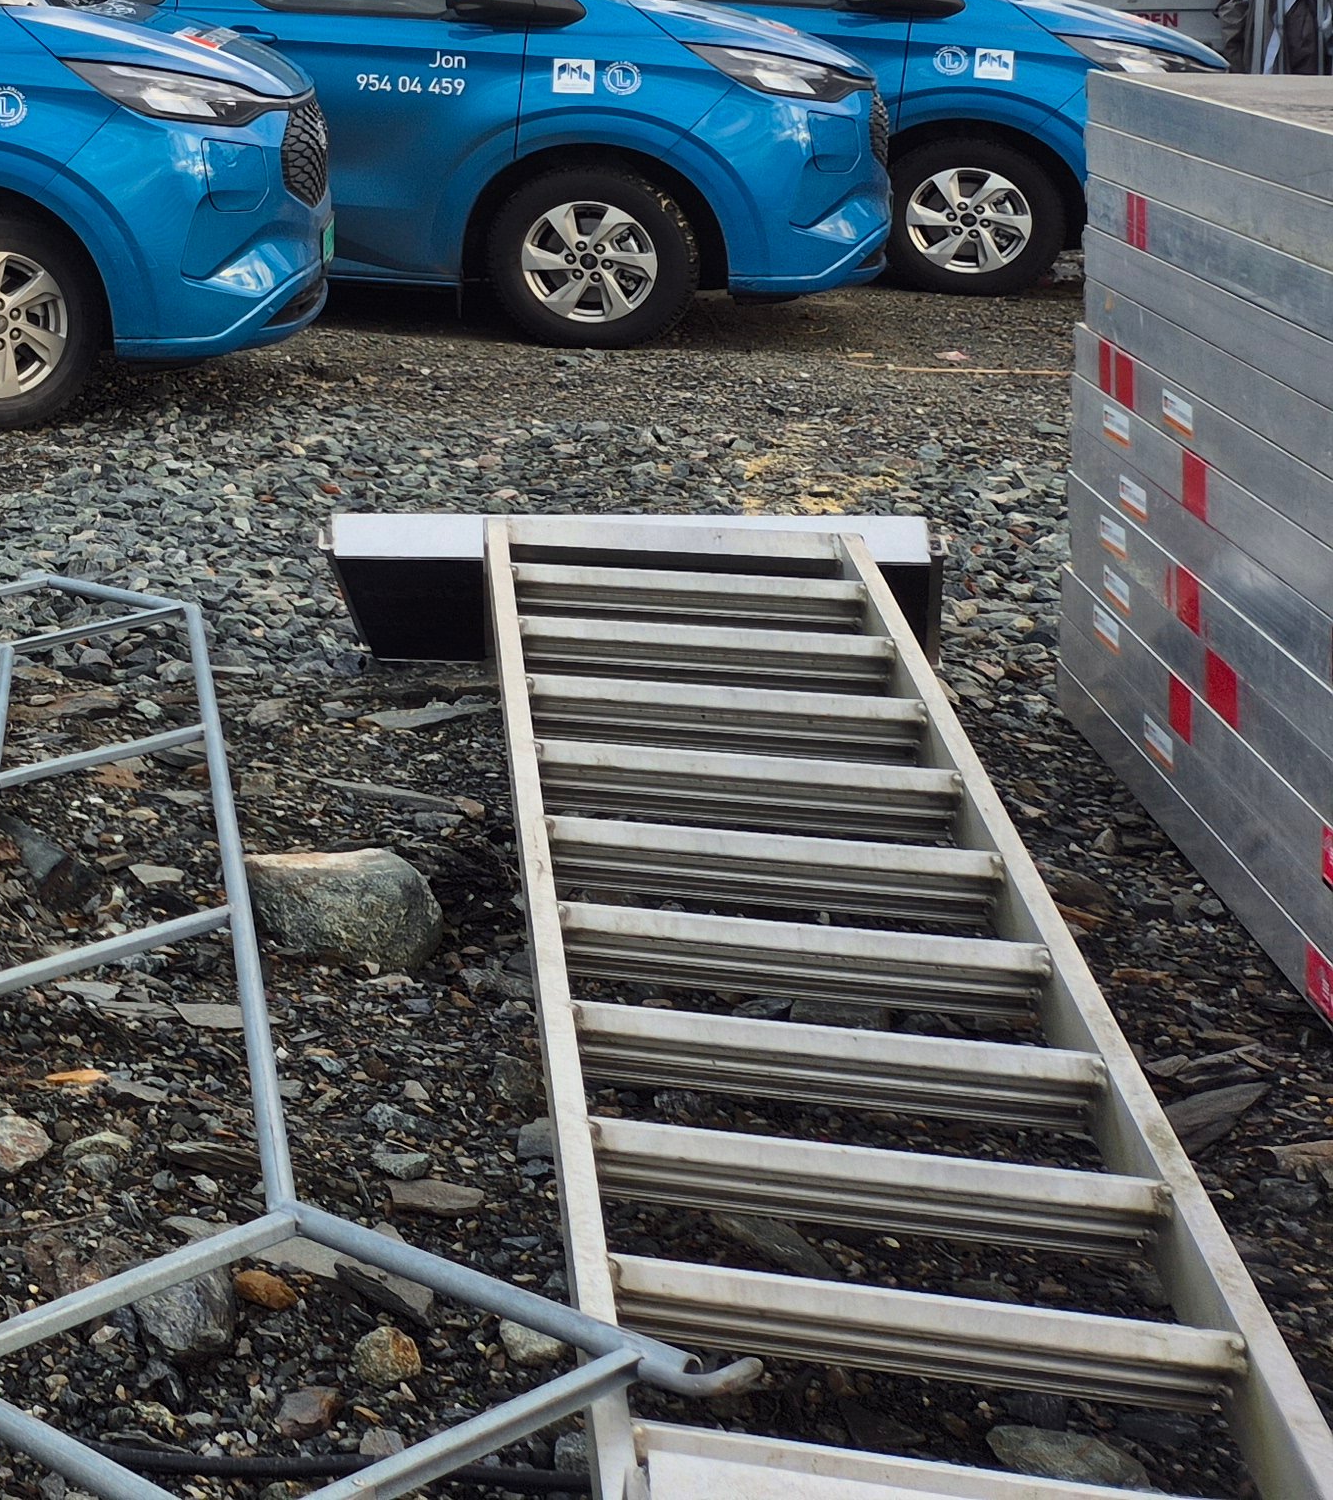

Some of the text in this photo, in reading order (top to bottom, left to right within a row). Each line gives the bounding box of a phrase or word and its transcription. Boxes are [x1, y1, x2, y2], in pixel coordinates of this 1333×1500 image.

[428, 50, 467, 70] Jon
[356, 73, 466, 96] 954 04 459
